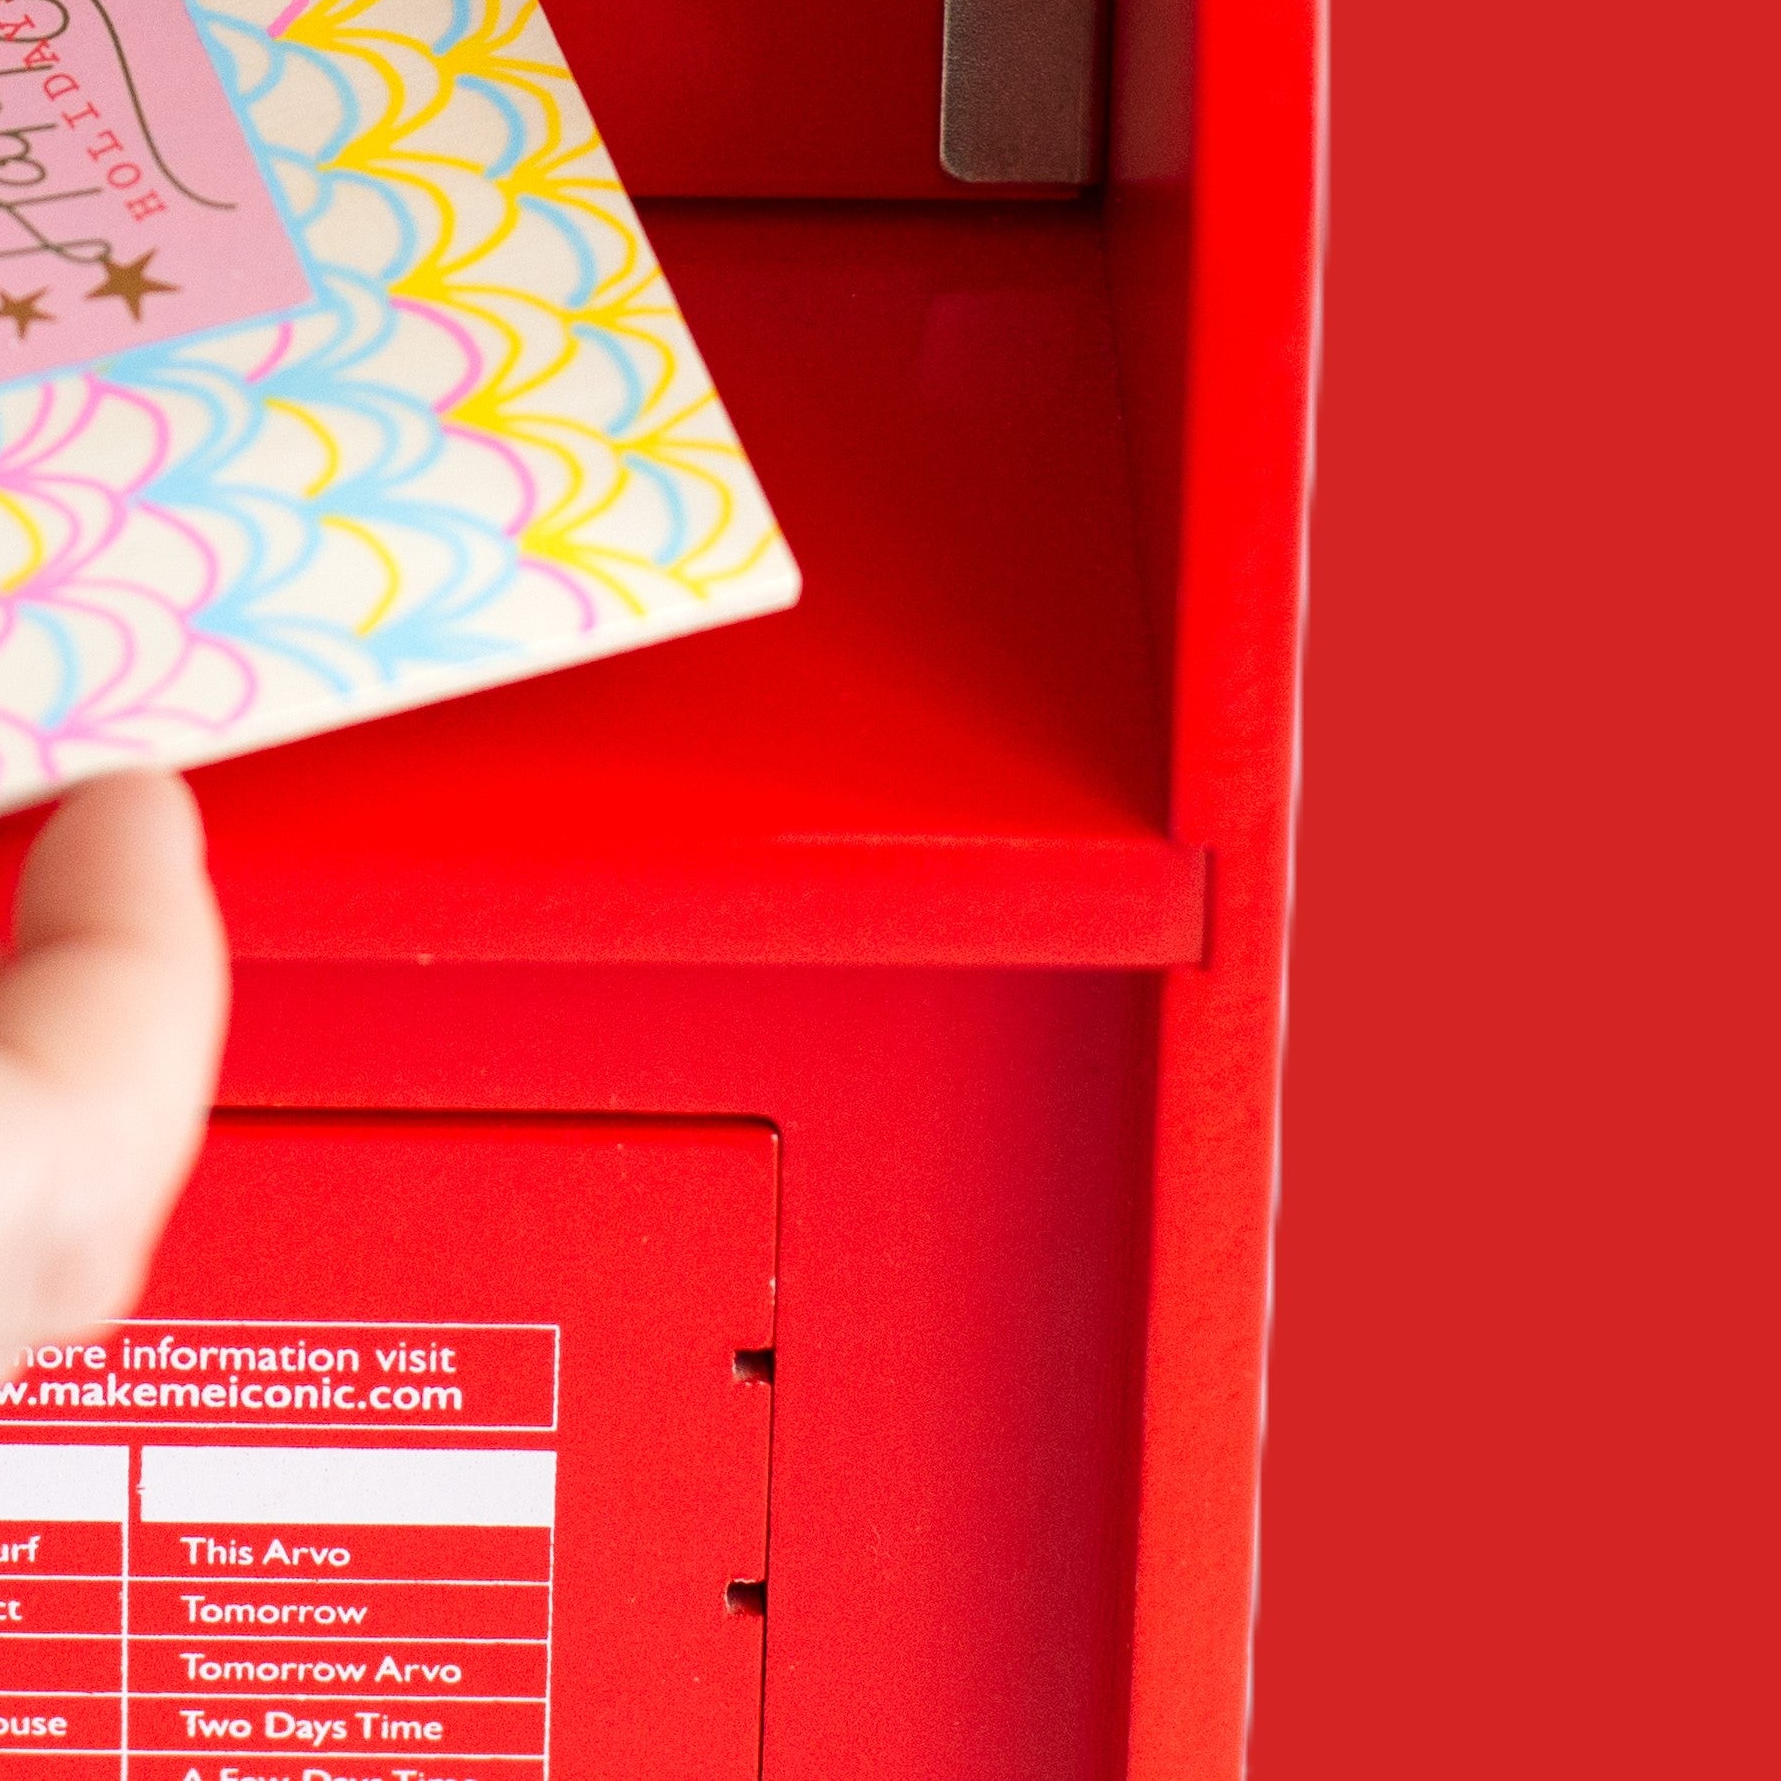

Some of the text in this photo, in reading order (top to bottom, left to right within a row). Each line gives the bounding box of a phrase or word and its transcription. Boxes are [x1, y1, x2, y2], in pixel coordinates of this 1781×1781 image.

[122, 1335, 360, 1372] information
[375, 1341, 457, 1374] visit
[179, 1536, 351, 1567] This Arvo
[180, 1594, 368, 1625] Tomorrow
[179, 1652, 462, 1684] Tomorrow Arvo
[179, 1709, 444, 1747] Two Days Time
